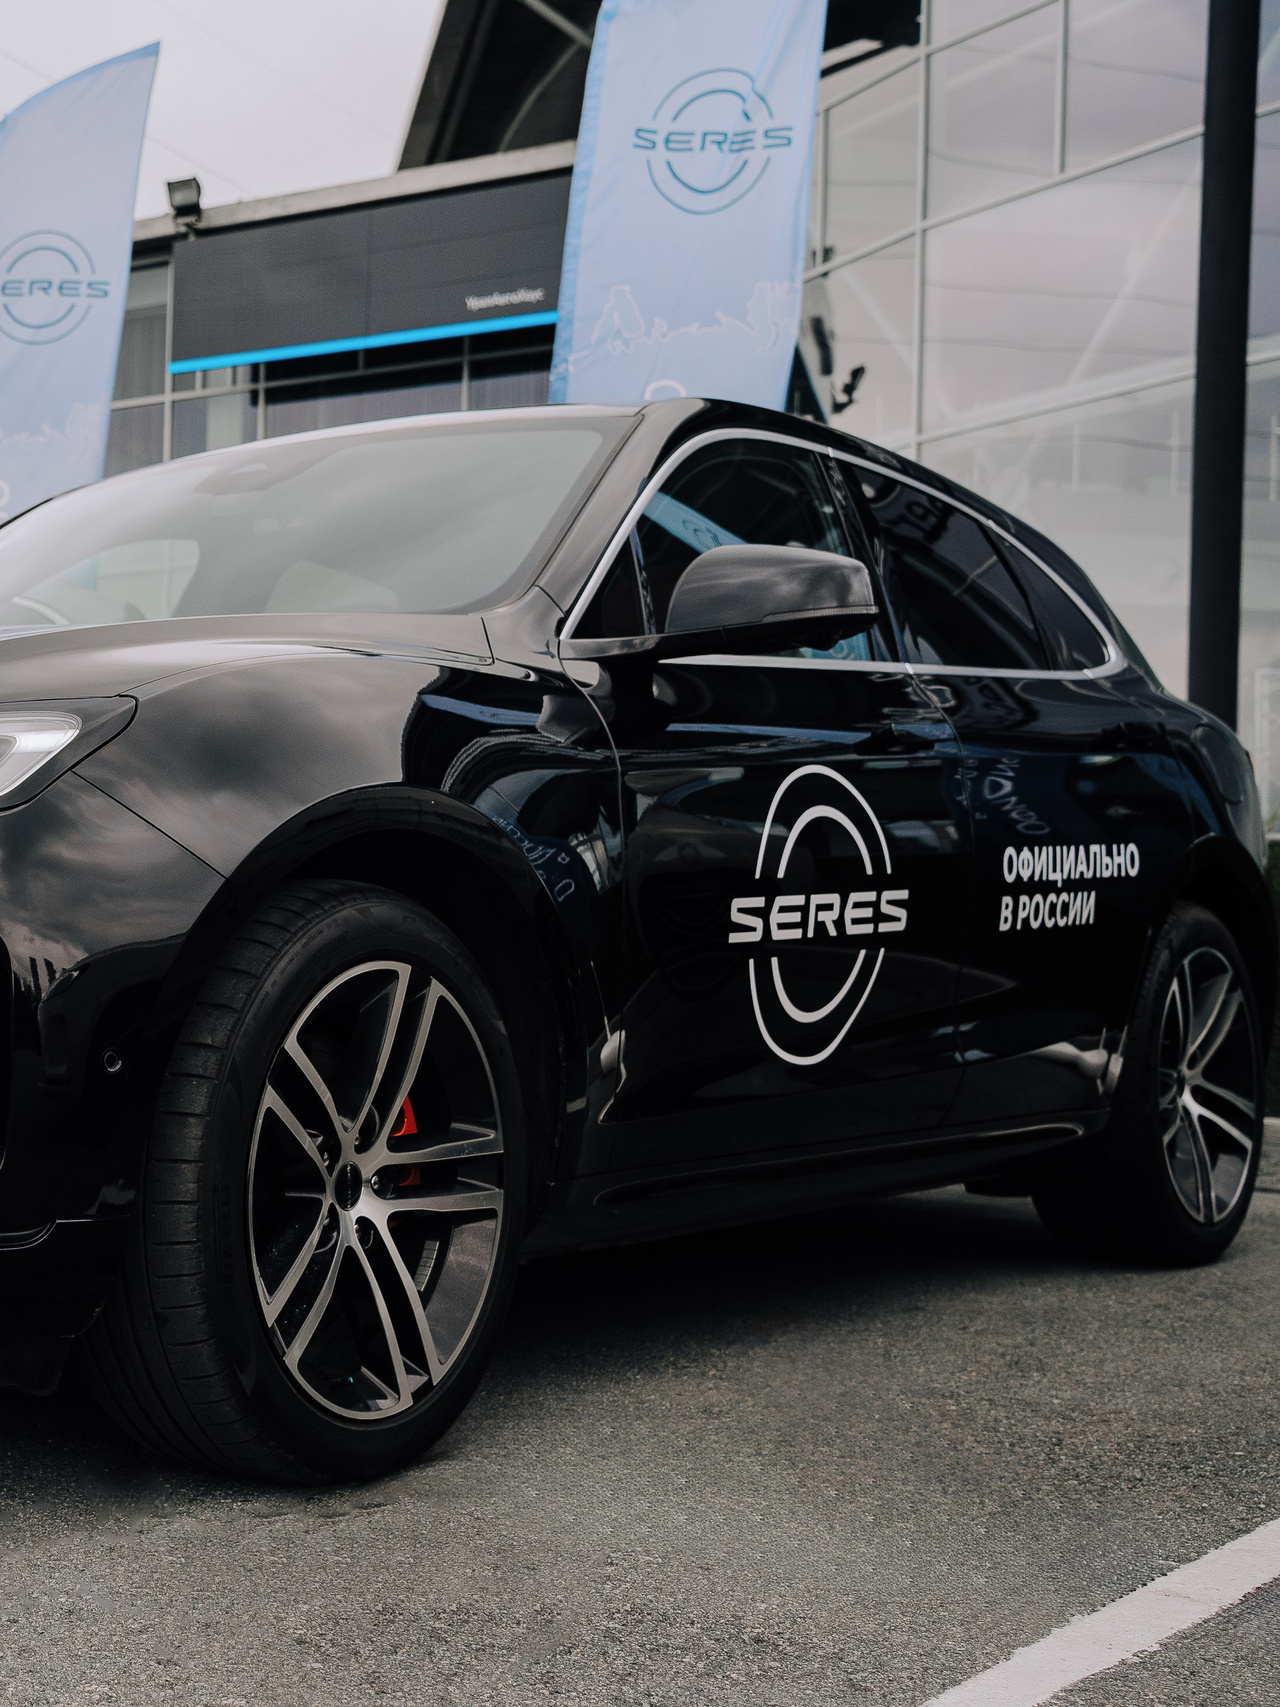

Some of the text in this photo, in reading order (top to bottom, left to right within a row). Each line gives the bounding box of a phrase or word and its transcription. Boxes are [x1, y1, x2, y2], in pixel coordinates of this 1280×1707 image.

[632, 127, 793, 153] SERES
[1002, 842, 1140, 888] ОФИЦИАЛЬНО
[728, 889, 909, 943] SERES
[999, 890, 1096, 931] В РОССИИ
